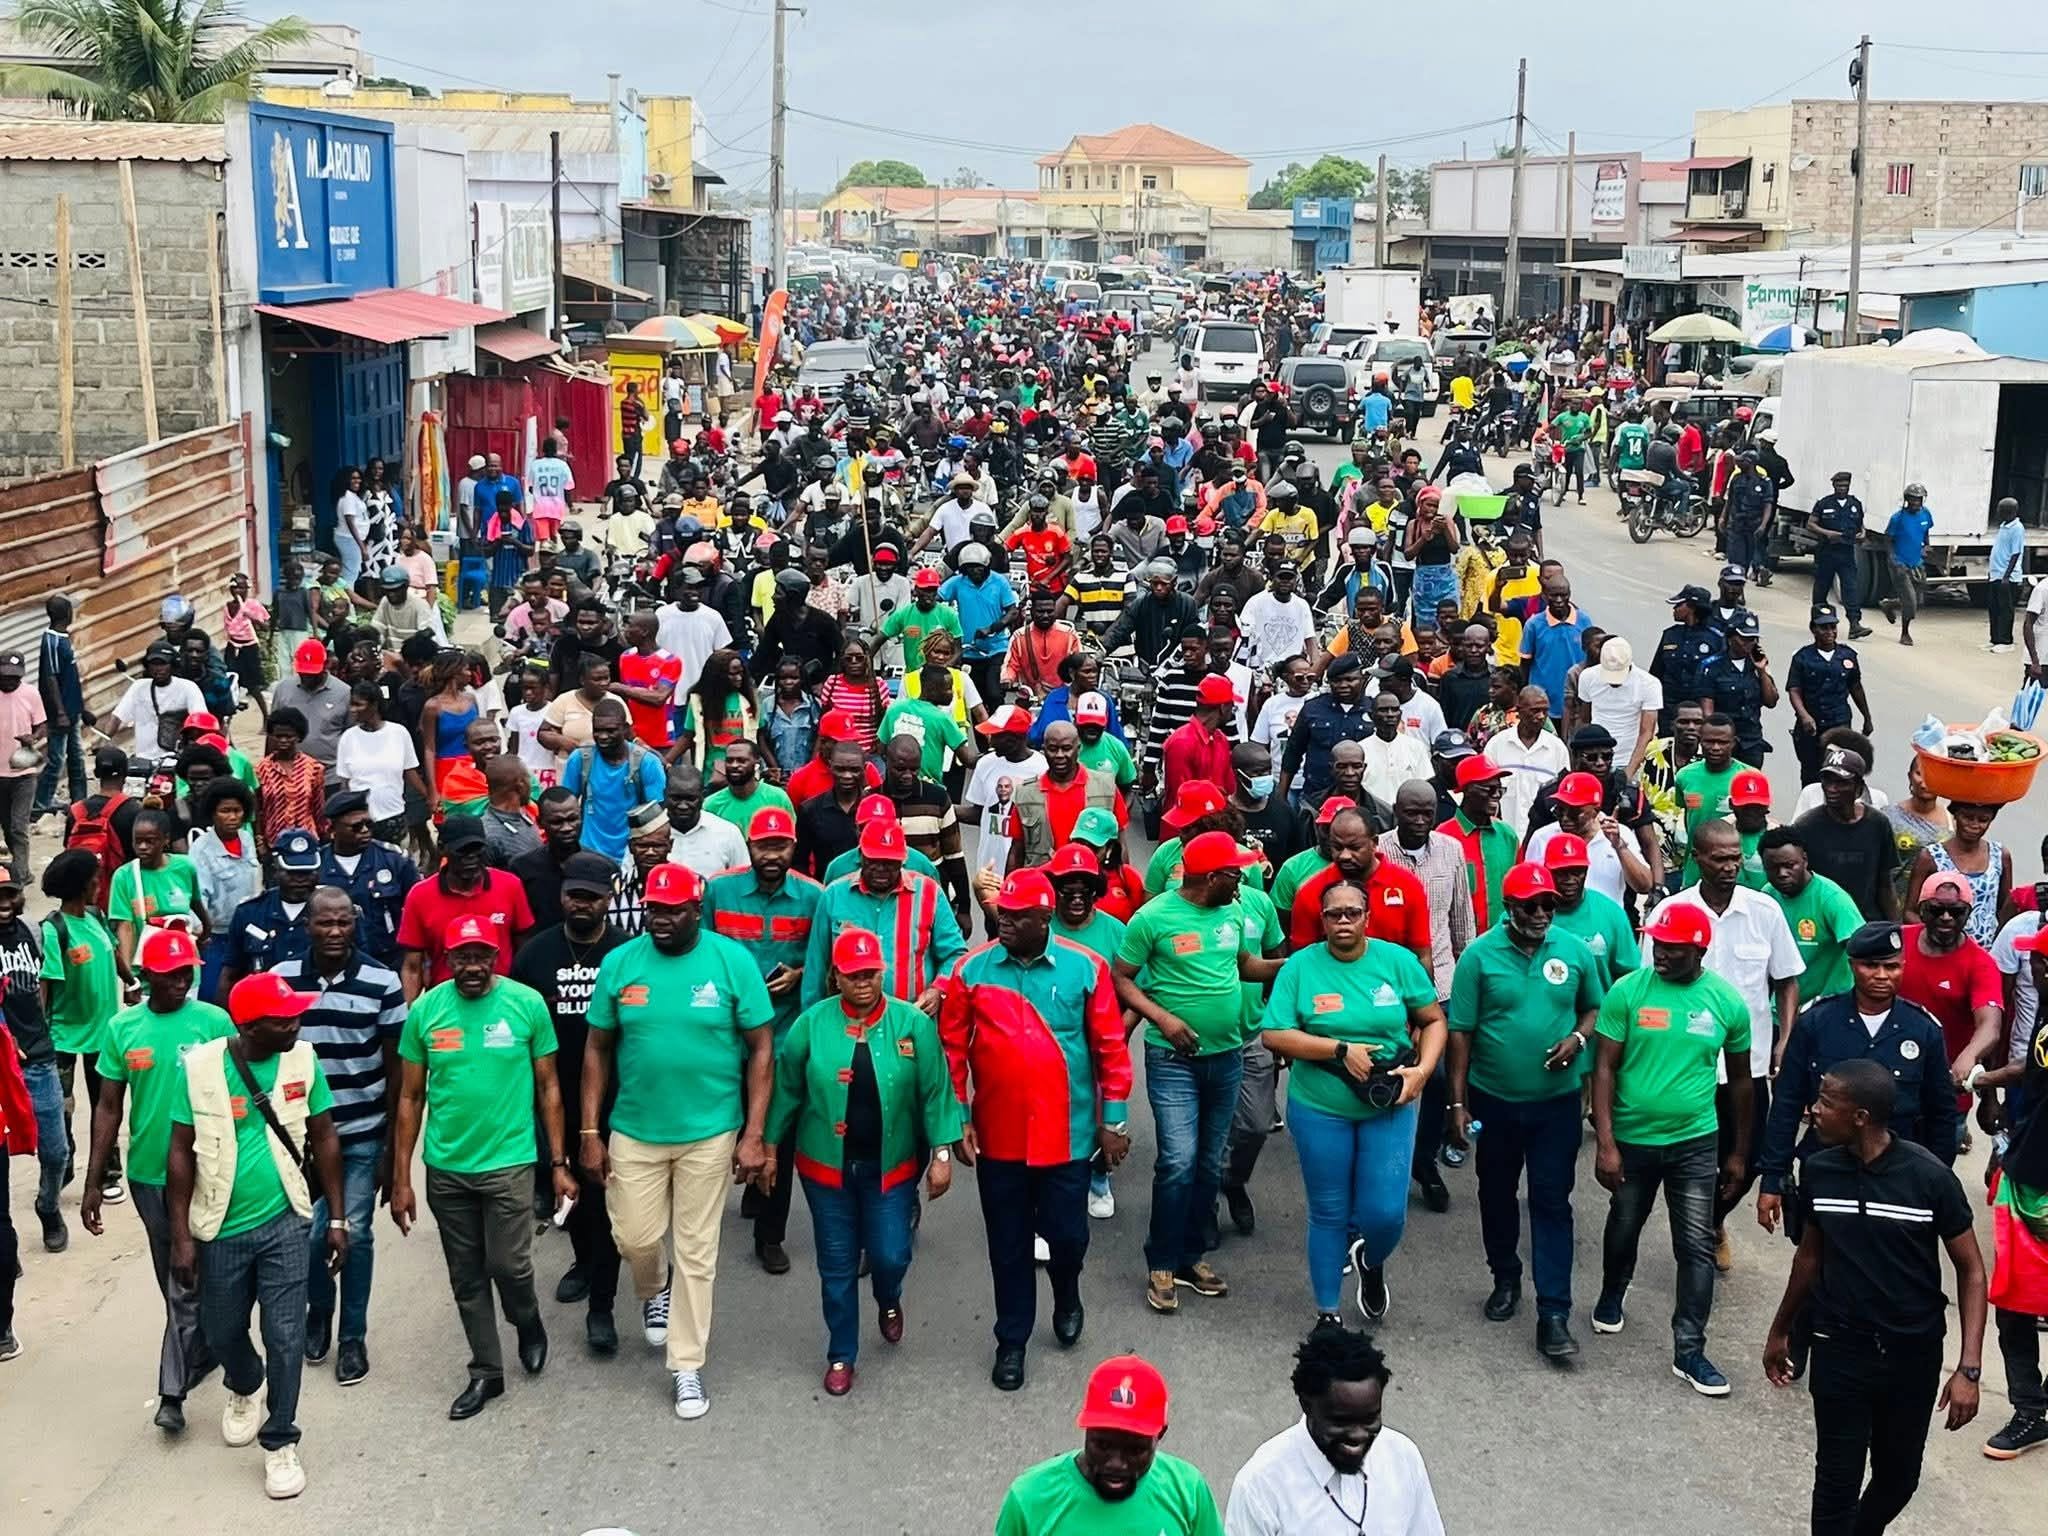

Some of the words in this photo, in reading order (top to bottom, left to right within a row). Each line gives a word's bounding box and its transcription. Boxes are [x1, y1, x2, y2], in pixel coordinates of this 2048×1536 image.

[1628, 438, 1642, 456] 14
[557, 984, 596, 998] YOU
[557, 1001, 591, 1014] BLU
